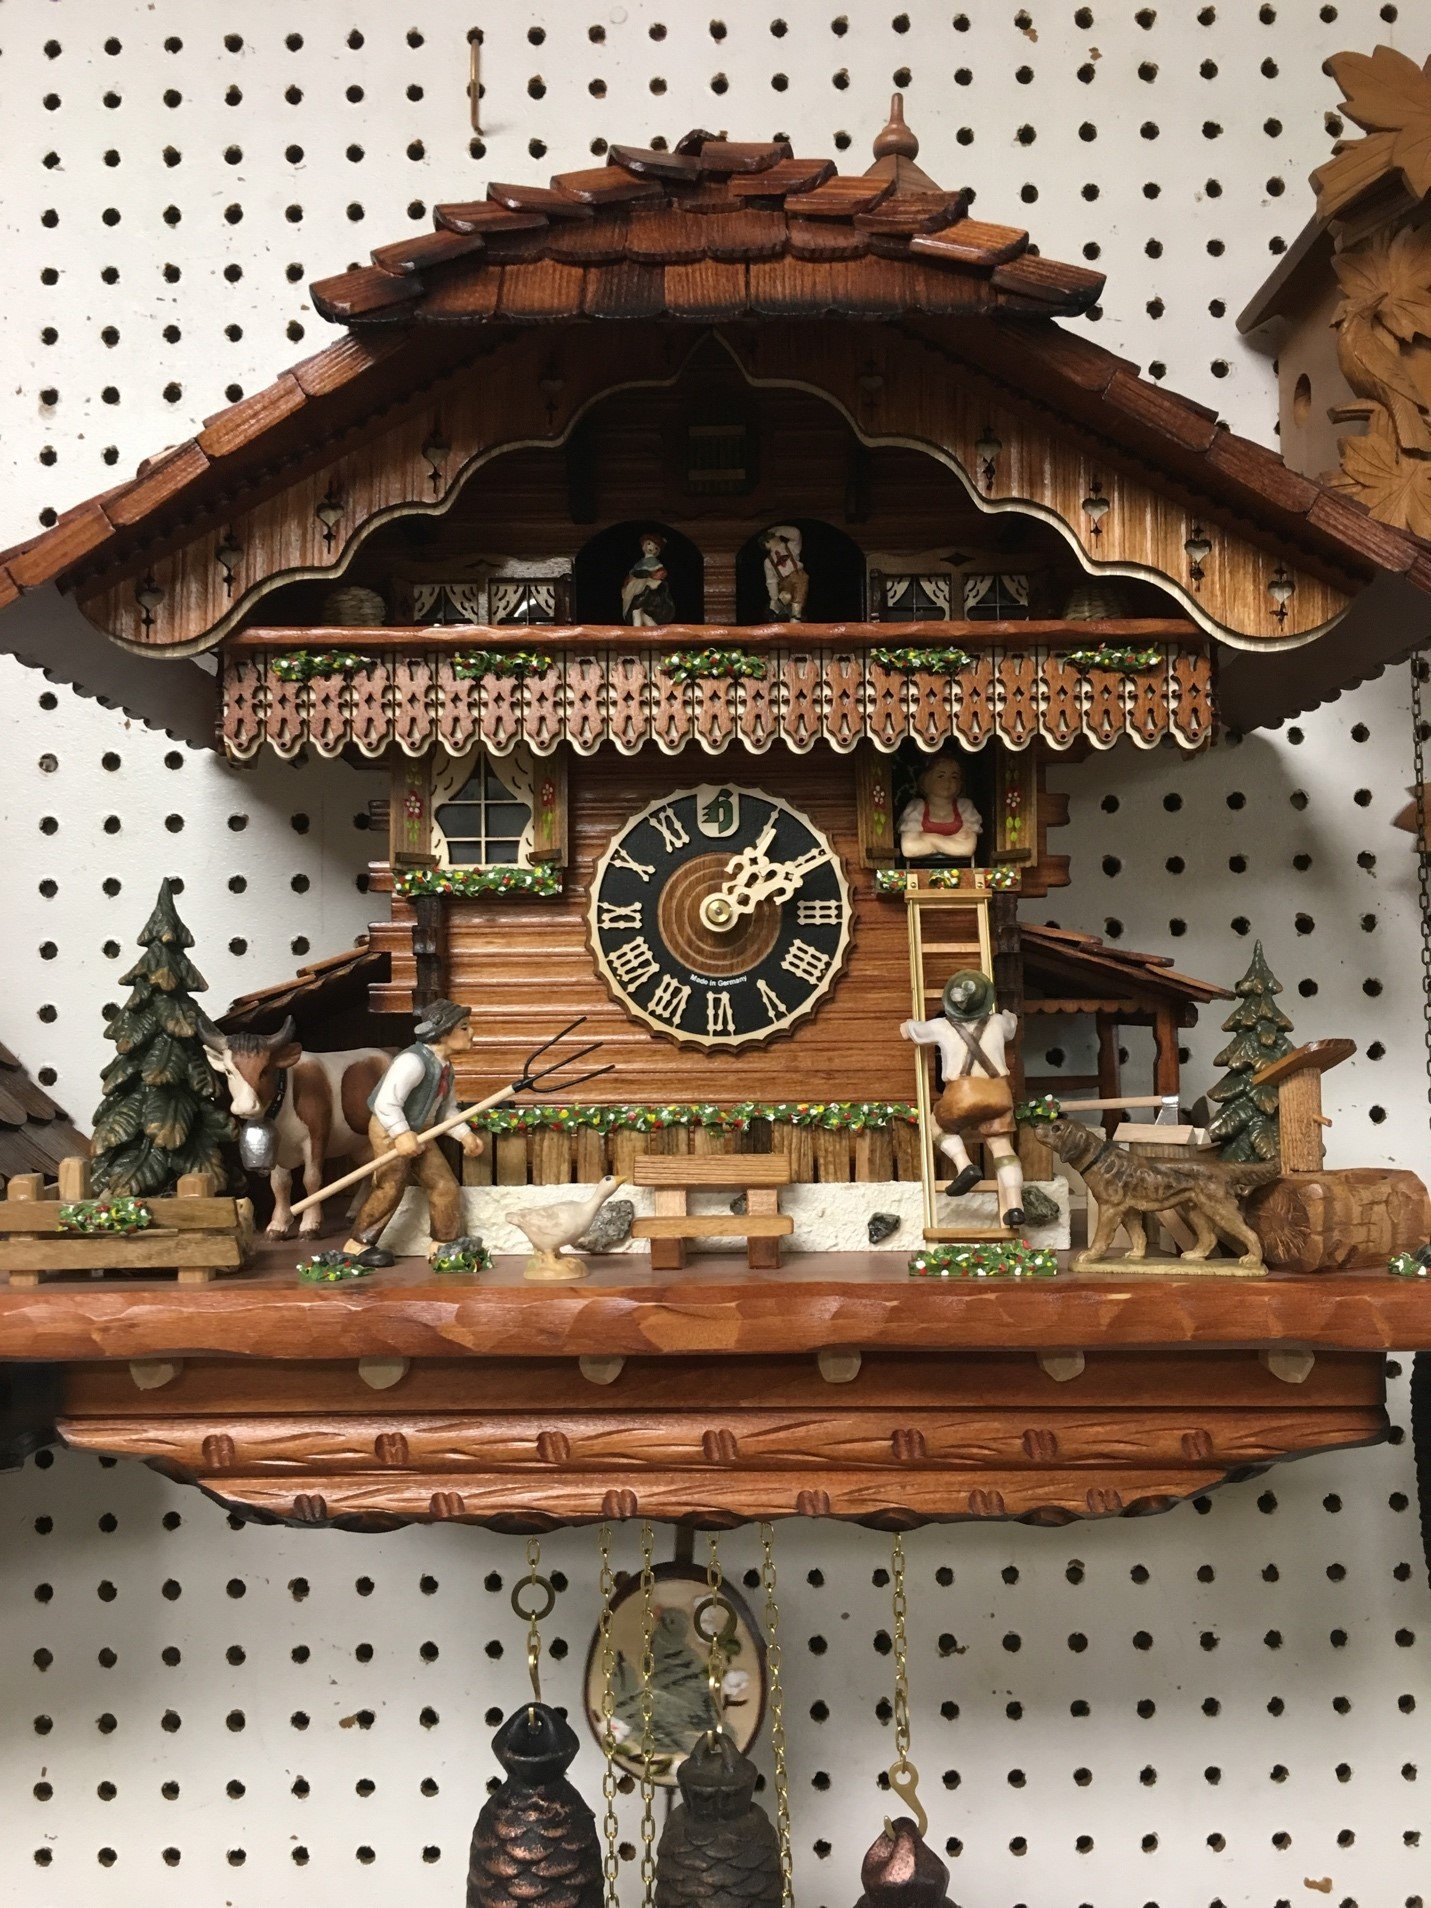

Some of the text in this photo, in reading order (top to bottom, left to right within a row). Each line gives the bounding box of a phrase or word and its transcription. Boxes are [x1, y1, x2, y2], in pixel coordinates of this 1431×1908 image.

[649, 804, 690, 853] XI
[609, 847, 656, 882] X
[600, 901, 642, 929] IX
[797, 900, 842, 925] III
[607, 936, 660, 994] VIII
[690, 974, 708, 985] Made
[718, 975, 747, 986] Germany
[781, 939, 832, 986] IIII
[648, 974, 692, 1027] VII
[706, 991, 736, 1036] VI
[757, 979, 788, 1022] V
